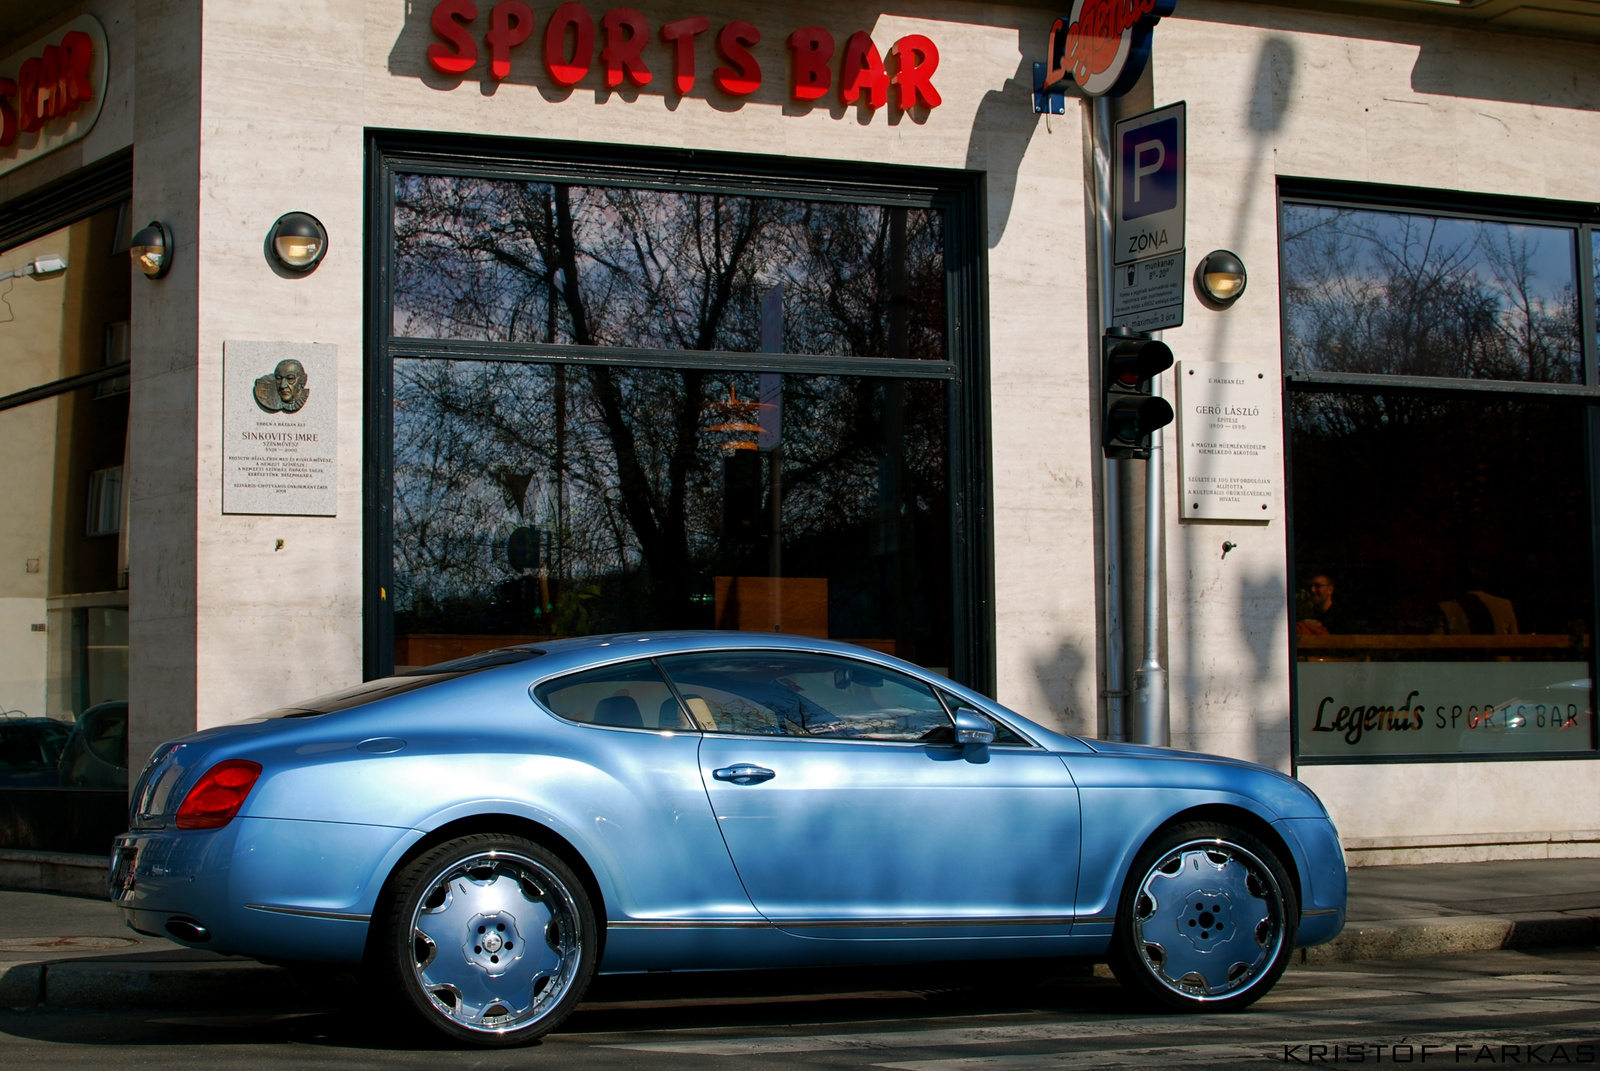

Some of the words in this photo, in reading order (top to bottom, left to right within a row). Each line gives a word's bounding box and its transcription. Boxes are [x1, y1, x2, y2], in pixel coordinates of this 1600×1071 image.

[426, 0, 762, 98] SPORTS
[787, 26, 943, 111] BAR
[1134, 139, 1166, 203] P
[1128, 229, 1168, 254] ZÓNA
[1144, 259, 1175, 271] munkanap
[1131, 316, 1159, 328] maximum
[1160, 314, 1165, 322] 3
[1165, 312, 1176, 321] óra
[1195, 404, 1221, 415] GERŐ
[1224, 405, 1259, 416] LÁSZLÓ
[242, 432, 293, 441] SINKOVITS
[295, 433, 319, 442] IMRE
[1311, 689, 1425, 746] Legends
[1435, 703, 1527, 730] SPORTS
[1535, 703, 1580, 730] BAR
